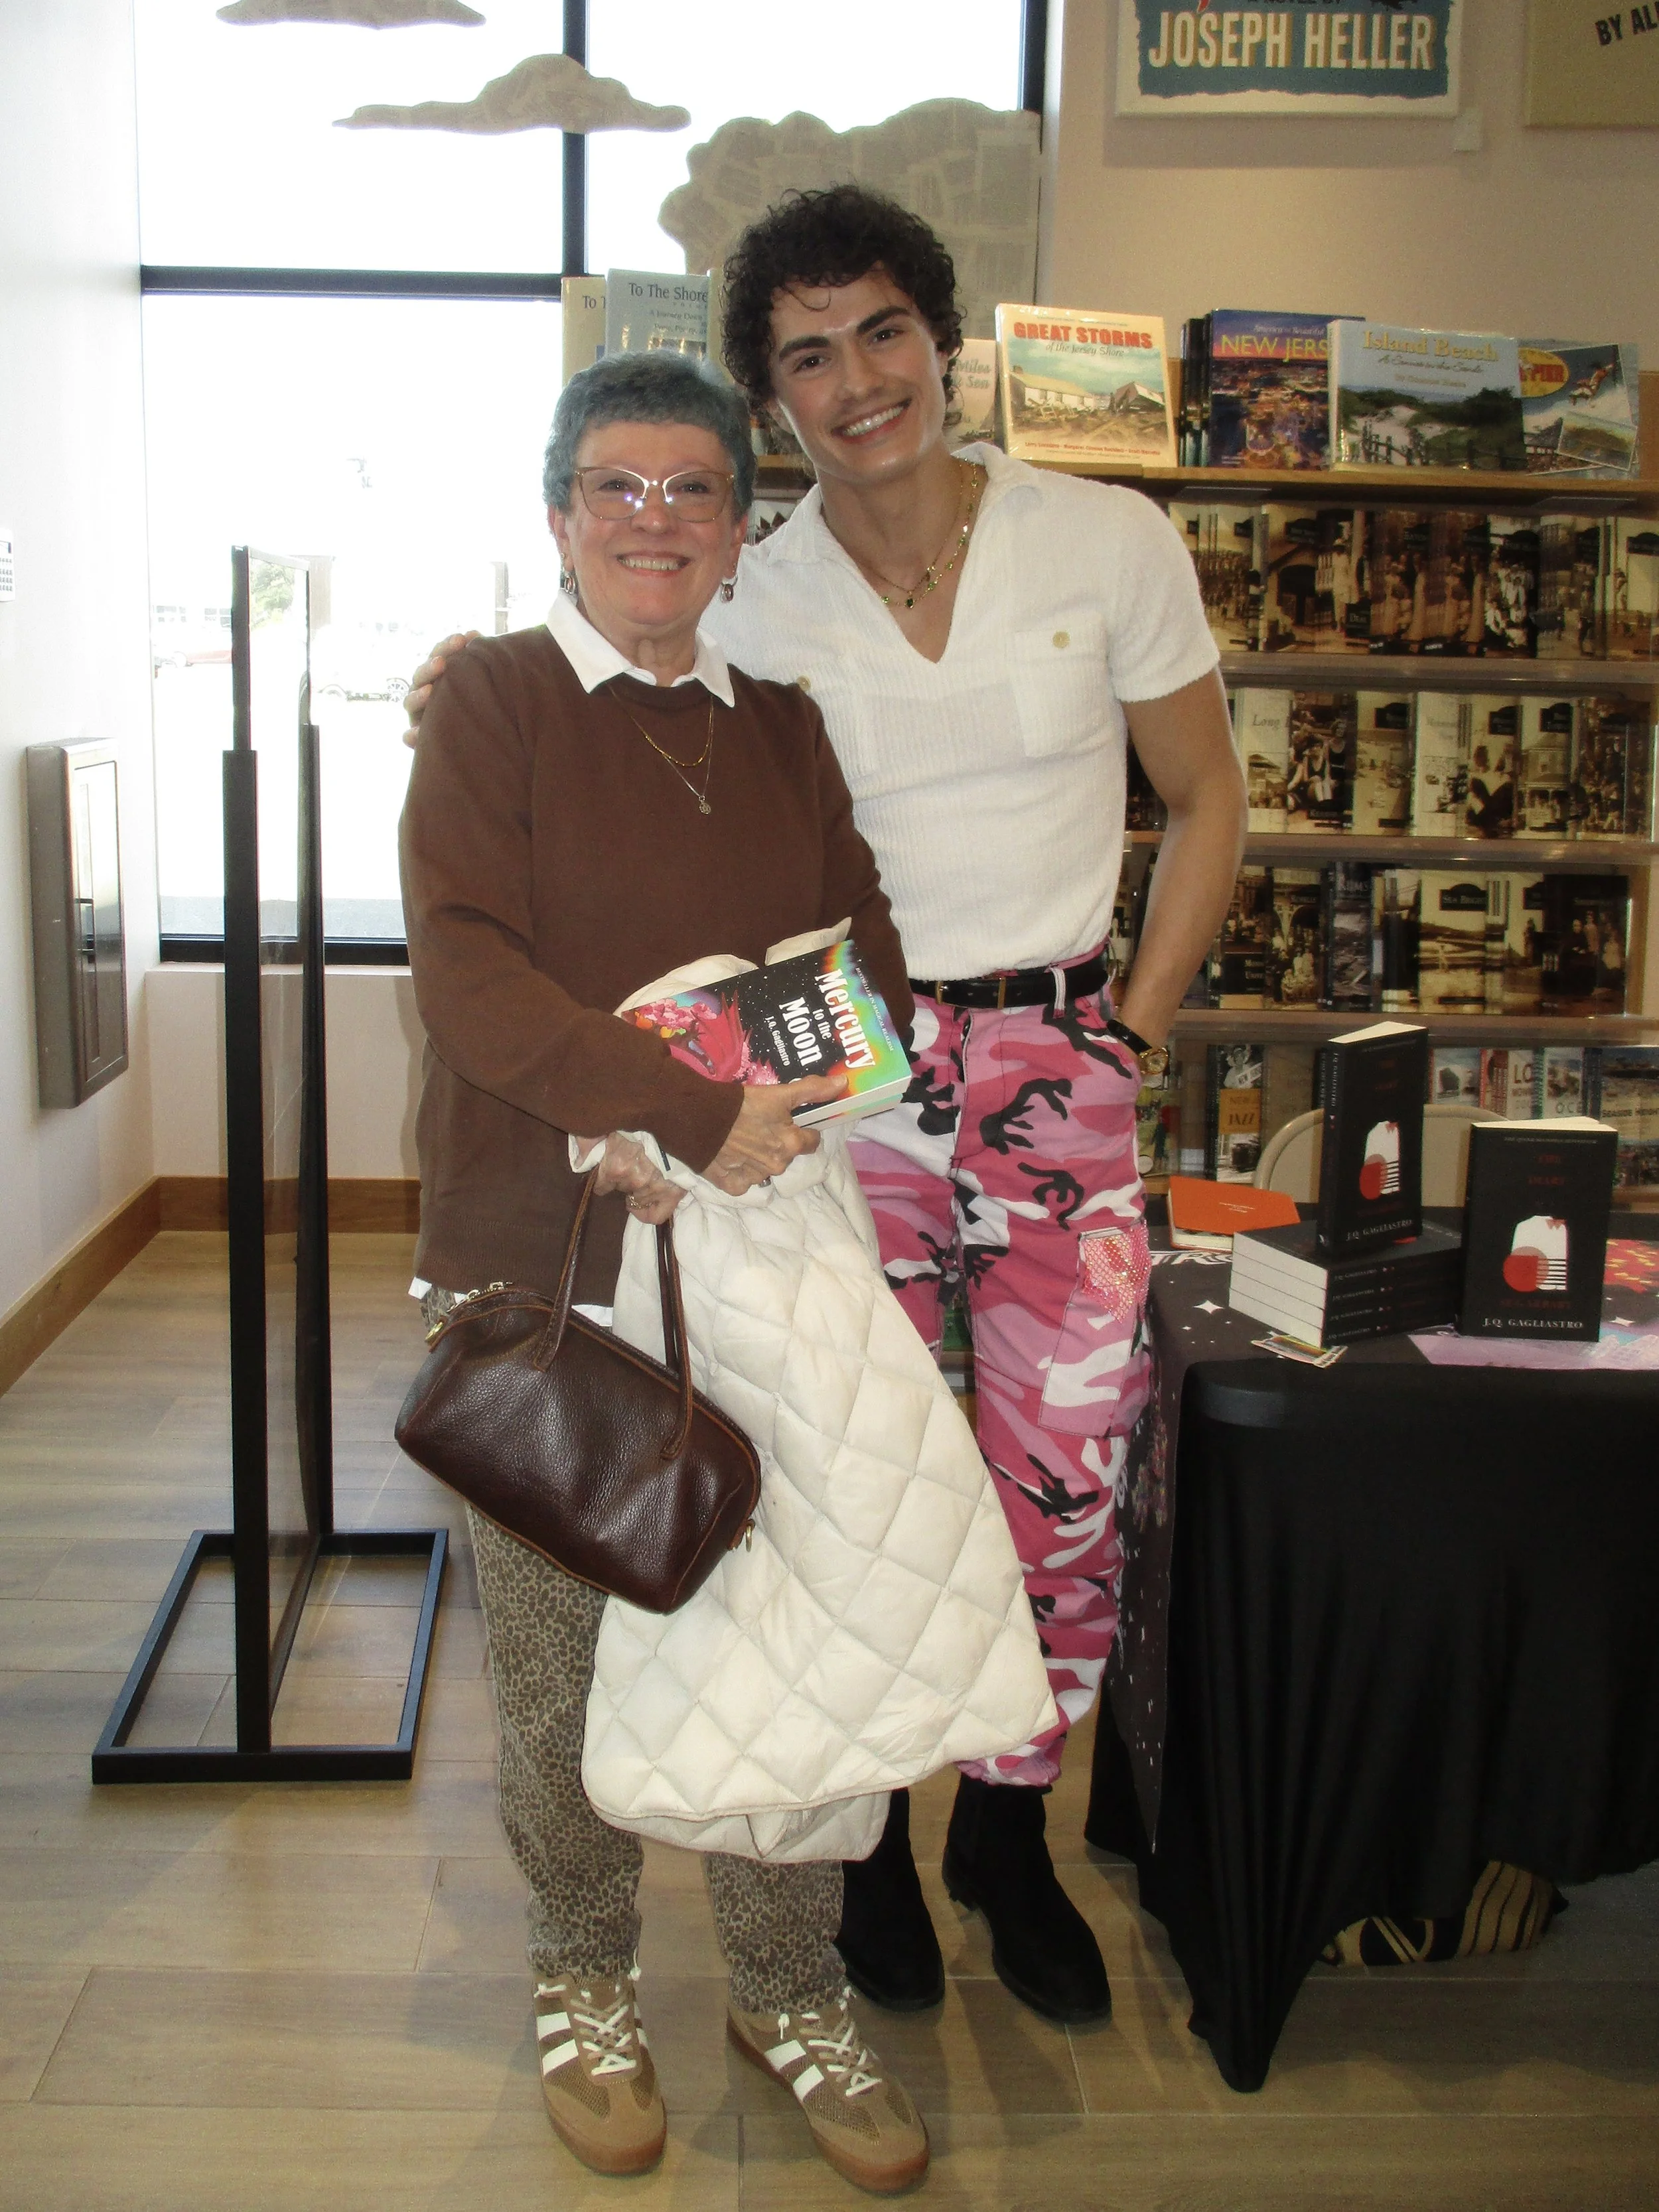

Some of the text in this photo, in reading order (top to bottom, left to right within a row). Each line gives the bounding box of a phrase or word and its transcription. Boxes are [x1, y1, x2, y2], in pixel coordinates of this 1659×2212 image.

[1147, 11, 1437, 70] JOSEPH HELLER
[1595, 14, 1623, 46] BY
[583, 295, 597, 309] To
[629, 283, 707, 303] To The Shore
[1013, 322, 1153, 349] GREAT STORMS
[1221, 334, 1278, 357] NEW
[1363, 330, 1499, 362] Island Beach
[812, 1008, 832, 1040] to the
[814, 969, 875, 1070] Mercury
[872, 1004, 885, 1027] MAGICAL
[778, 997, 823, 1067] Moon
[1228, 1112, 1255, 1126] JAZZ
[1508, 1318, 1583, 1329] GAGLIASTRO
